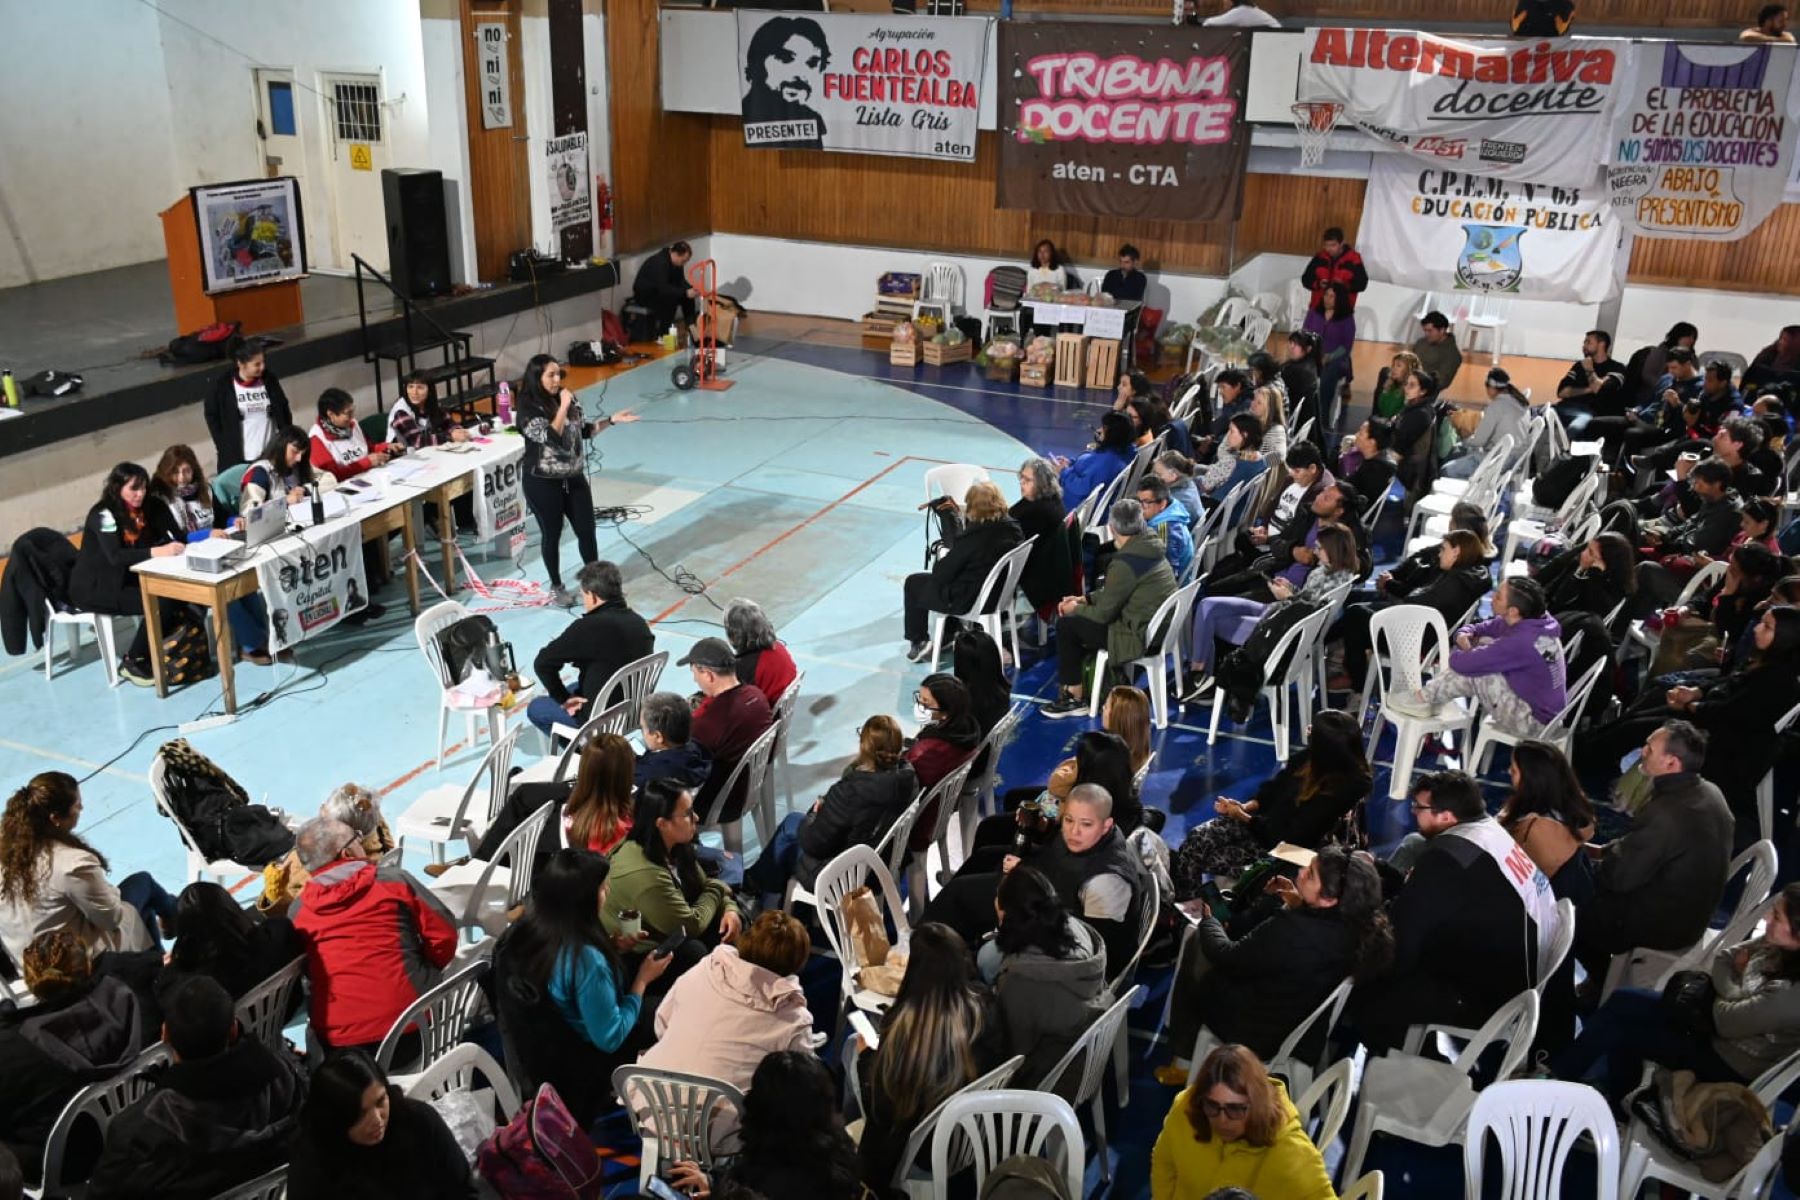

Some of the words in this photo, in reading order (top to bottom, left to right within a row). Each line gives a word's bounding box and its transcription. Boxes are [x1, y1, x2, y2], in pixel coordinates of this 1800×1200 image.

[484, 28, 501, 42] no
[868, 27, 935, 42] Agrupación
[486, 56, 500, 73] ni
[852, 46, 951, 78] CARLOS
[1310, 27, 1616, 84] Alternativa
[1029, 54, 1229, 99] TRIBUNA
[489, 87, 502, 104] ni
[823, 73, 977, 109] FUENTEALBA
[1433, 79, 1604, 114] docente
[1646, 87, 1668, 111] EL
[1678, 88, 1775, 114] PROBLEMA
[856, 105, 903, 126] Lista
[911, 109, 951, 130] Gris
[1021, 101, 1234, 142] DOCENTE
[1632, 113, 1661, 134] DE
[1661, 111, 1685, 137] LA
[1689, 111, 1784, 143] EDUCACIÓN
[746, 123, 814, 141] PRESENTE!
[934, 140, 971, 155] aten
[1618, 138, 1641, 162] NO
[1704, 140, 1779, 167] DOCENTES
[1052, 160, 1105, 182] aten
[1129, 164, 1179, 187] CTA
[1418, 169, 1510, 201] C.P.E.M.
[1660, 167, 1719, 193] ABAJO
[1411, 196, 1518, 222] EDUCACIÓN
[1524, 206, 1602, 232] PÚBLICA
[1639, 198, 1740, 227] PRESENTISMO
[239, 391, 269, 402] aten
[279, 543, 348, 594] aten
[296, 580, 332, 606] Capital
